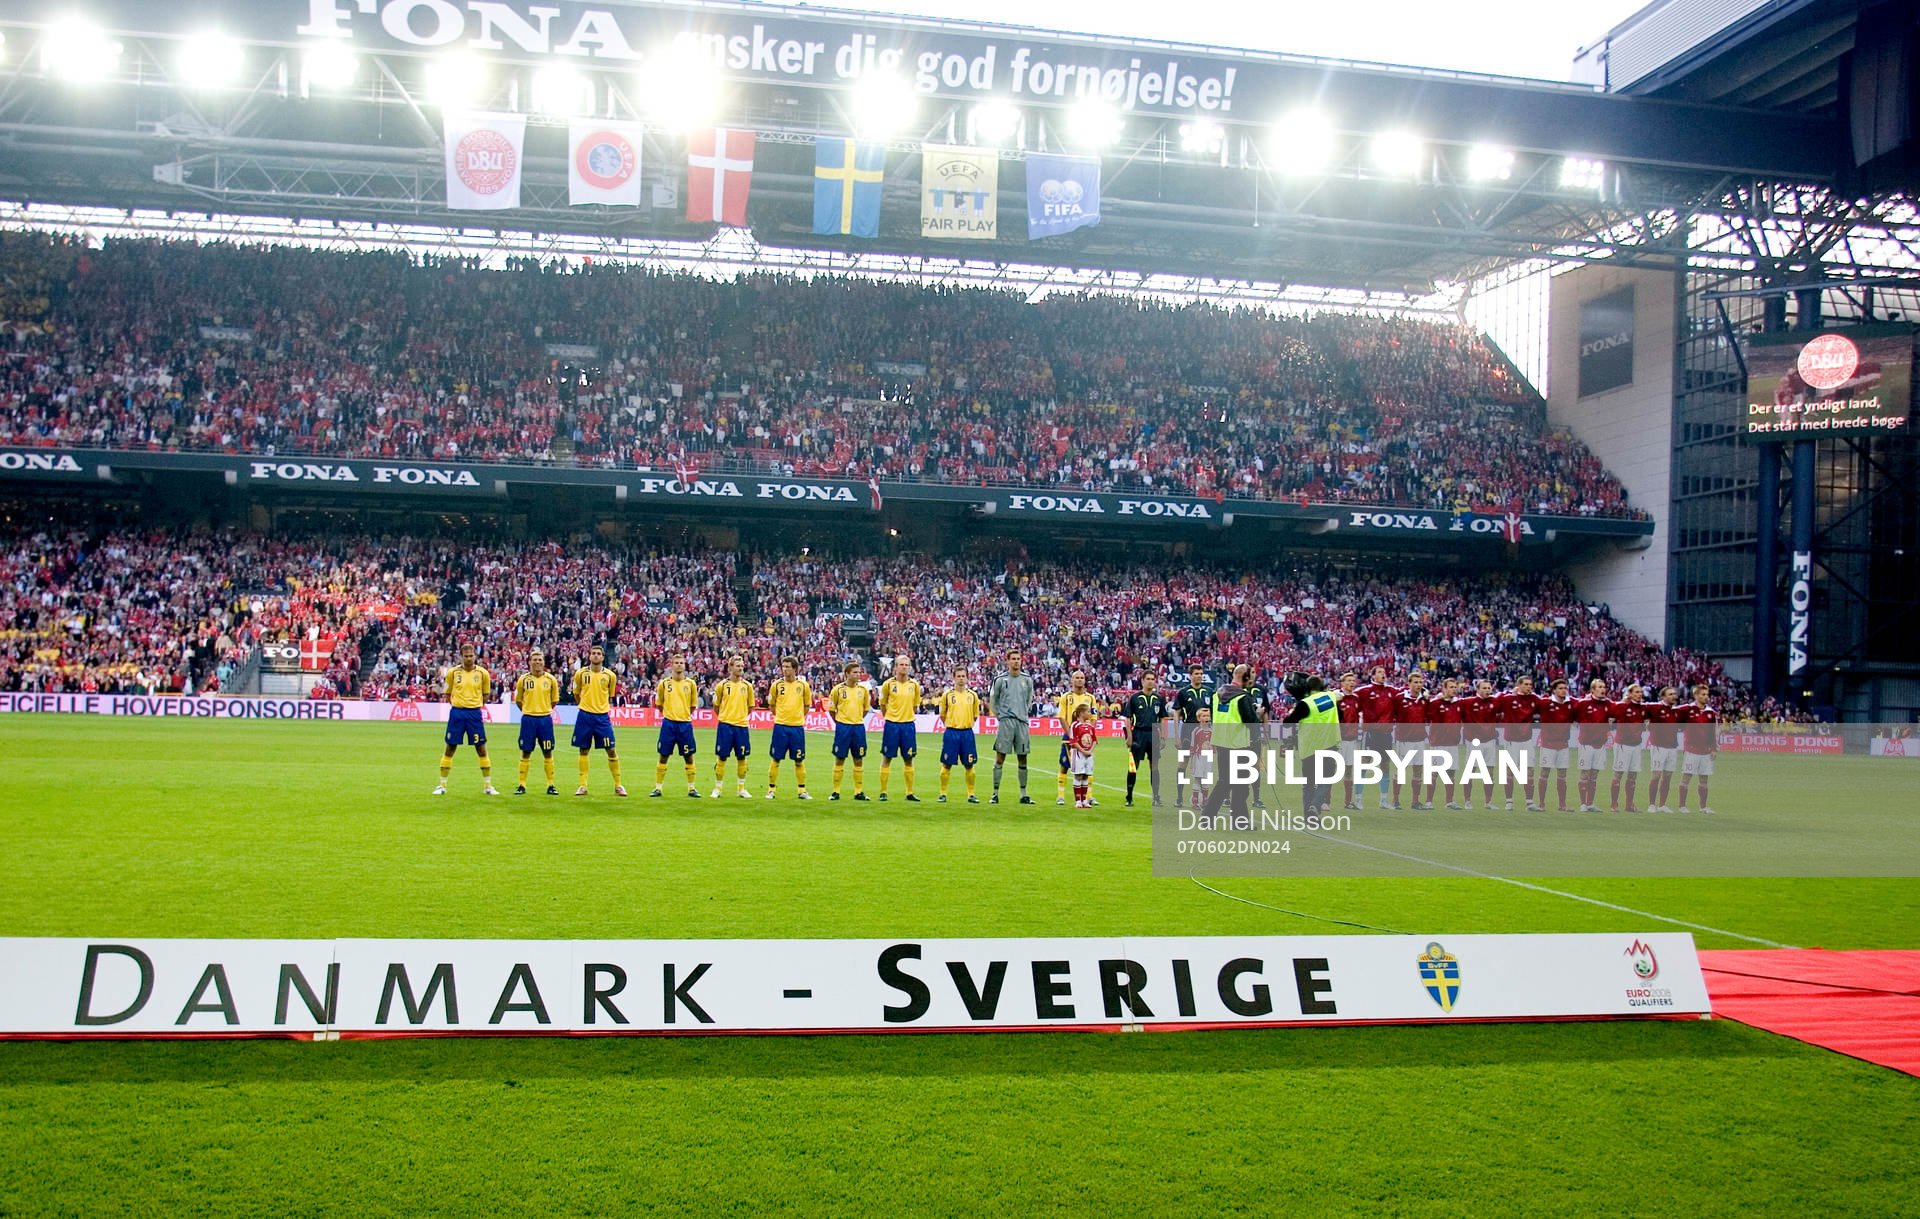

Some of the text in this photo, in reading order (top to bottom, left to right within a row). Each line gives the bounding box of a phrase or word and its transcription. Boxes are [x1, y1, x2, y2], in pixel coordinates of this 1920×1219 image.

[297, 0, 643, 61] FONA
[914, 46, 997, 95] god
[1011, 48, 1237, 112] fornøjelse!
[467, 151, 504, 170] DBU
[939, 163, 979, 180] UEFA
[1044, 203, 1083, 217] FIFA
[922, 217, 994, 232] FAIR PLAY
[1582, 333, 1630, 357] FONA
[1810, 352, 1844, 369] DBU
[1749, 404, 1771, 415] Der
[1773, 404, 1786, 414] er
[1789, 402, 1802, 413] et
[1804, 399, 1846, 414] yndigt
[1749, 415, 1905, 433] Det står med brede bøge
[0, 453, 82, 471] ONA
[250, 463, 480, 486] FONA FONA
[640, 478, 858, 501] FONA FONA
[1009, 495, 1212, 518] FONA FONA
[1349, 512, 1437, 530] FONA
[1790, 550, 1811, 675] FONA
[263, 647, 299, 658] FO
[457, 675, 462, 684] 3
[526, 681, 534, 689] 10
[584, 676, 590, 684] 11
[780, 687, 785, 695] 2
[0, 695, 344, 720] FICIELLE HOVEDSPONSORER
[394, 705, 417, 717] Arla
[805, 716, 828, 726] Arla
[474, 734, 479, 743] 3
[543, 740, 551, 750] 10
[604, 738, 610, 746] 11
[1742, 736, 1787, 745] DONG
[1793, 738, 1839, 747] DONG
[684, 745, 689, 753] 5
[797, 750, 802, 758] 2
[860, 747, 865, 755] 8
[907, 747, 912, 755] 4
[968, 754, 973, 762] 6
[74, 943, 717, 1027] DANMARK
[877, 943, 1337, 1023] SVERIGE
[1629, 998, 1673, 1006] QUALIFIERS
